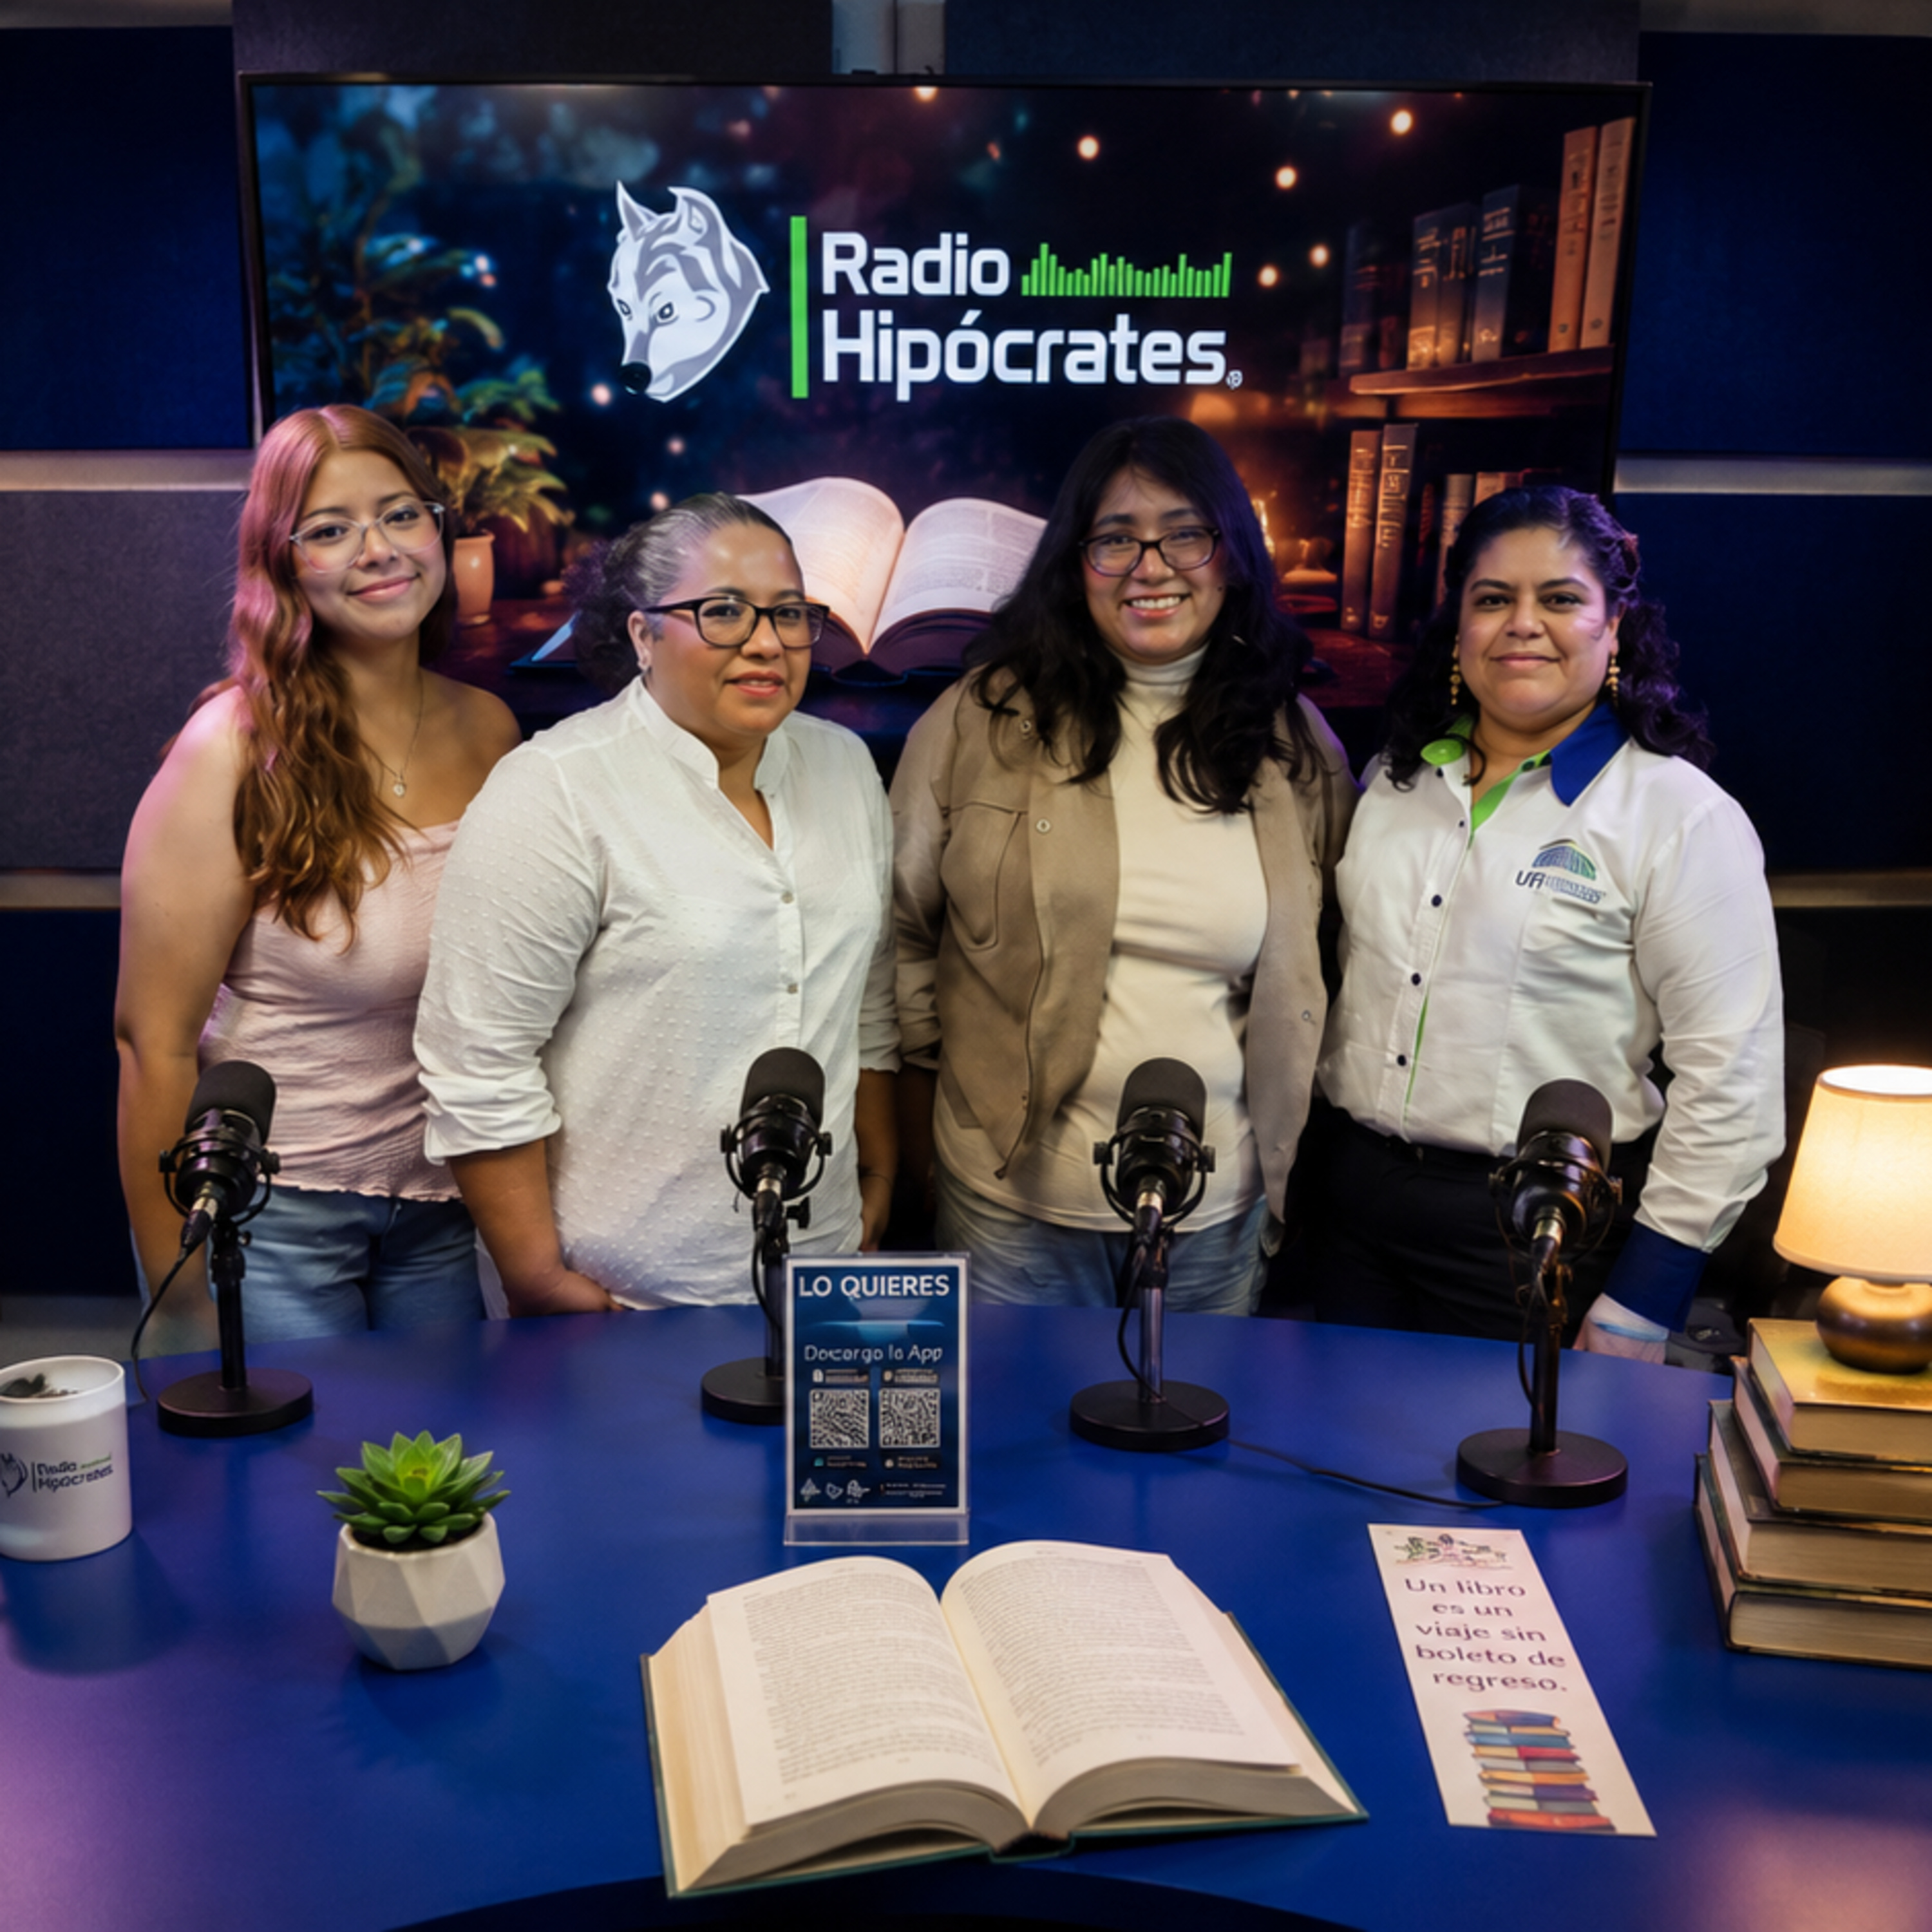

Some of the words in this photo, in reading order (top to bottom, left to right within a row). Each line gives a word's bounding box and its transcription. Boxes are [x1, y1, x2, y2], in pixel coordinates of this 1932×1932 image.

[822, 232, 1009, 295] Radio
[799, 1276, 832, 1297] LO
[840, 1274, 949, 1298] QUIERES
[907, 1344, 943, 1364] App
[1405, 1578, 1446, 1593] Un
[1456, 1580, 1526, 1596] libro
[1432, 1603, 1465, 1615] es
[1473, 1605, 1513, 1618] un
[1416, 1621, 1490, 1641] viaje
[1501, 1626, 1548, 1642] sin
[1416, 1644, 1517, 1665] boleto
[1528, 1650, 1566, 1667] de
[1433, 1672, 1568, 1692] regreso.
